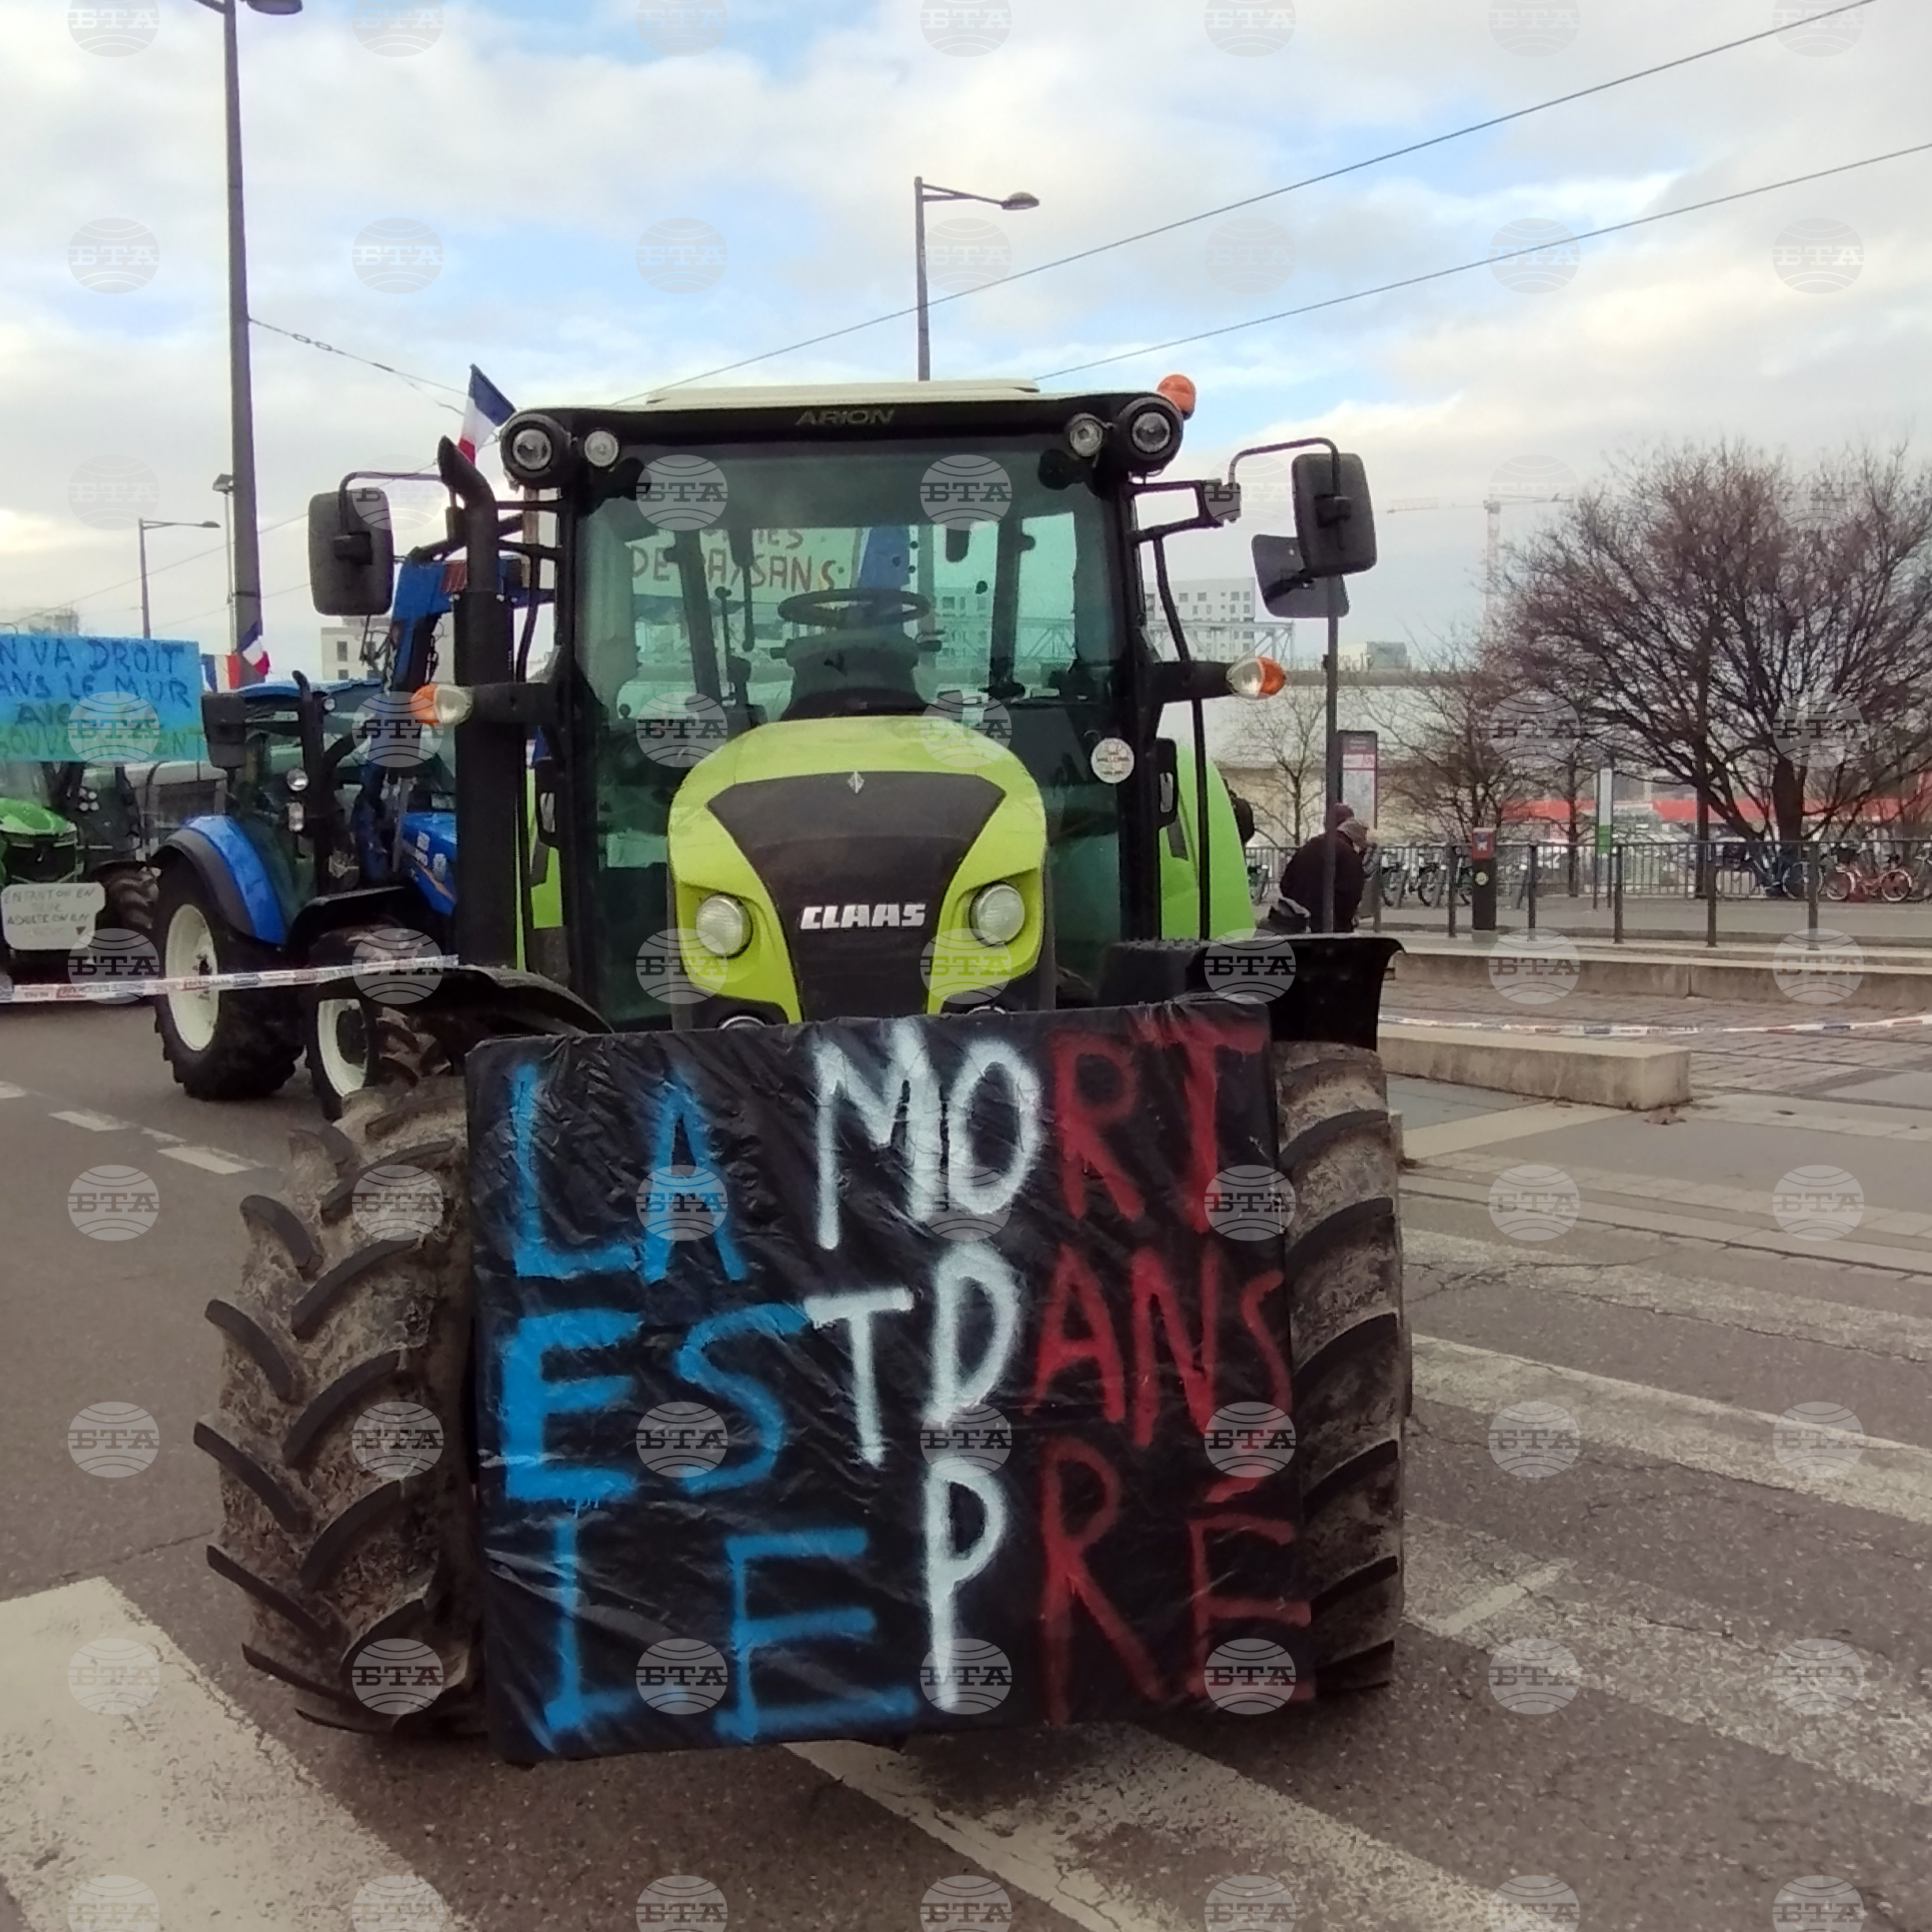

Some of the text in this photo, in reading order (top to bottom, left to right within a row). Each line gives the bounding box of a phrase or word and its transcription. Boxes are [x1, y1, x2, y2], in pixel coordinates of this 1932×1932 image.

[795, 410, 895, 425] ARION
[30, 638, 76, 669] VA
[87, 638, 185, 674] DROIT
[65, 672, 100, 700] LE
[114, 674, 192, 710] MUR
[800, 904, 926, 929] CLAAS
[508, 1017, 1264, 1284] LA MORT
[497, 1239, 1294, 1500] EST DANS
[545, 1438, 1316, 1742] LE PRÉ
